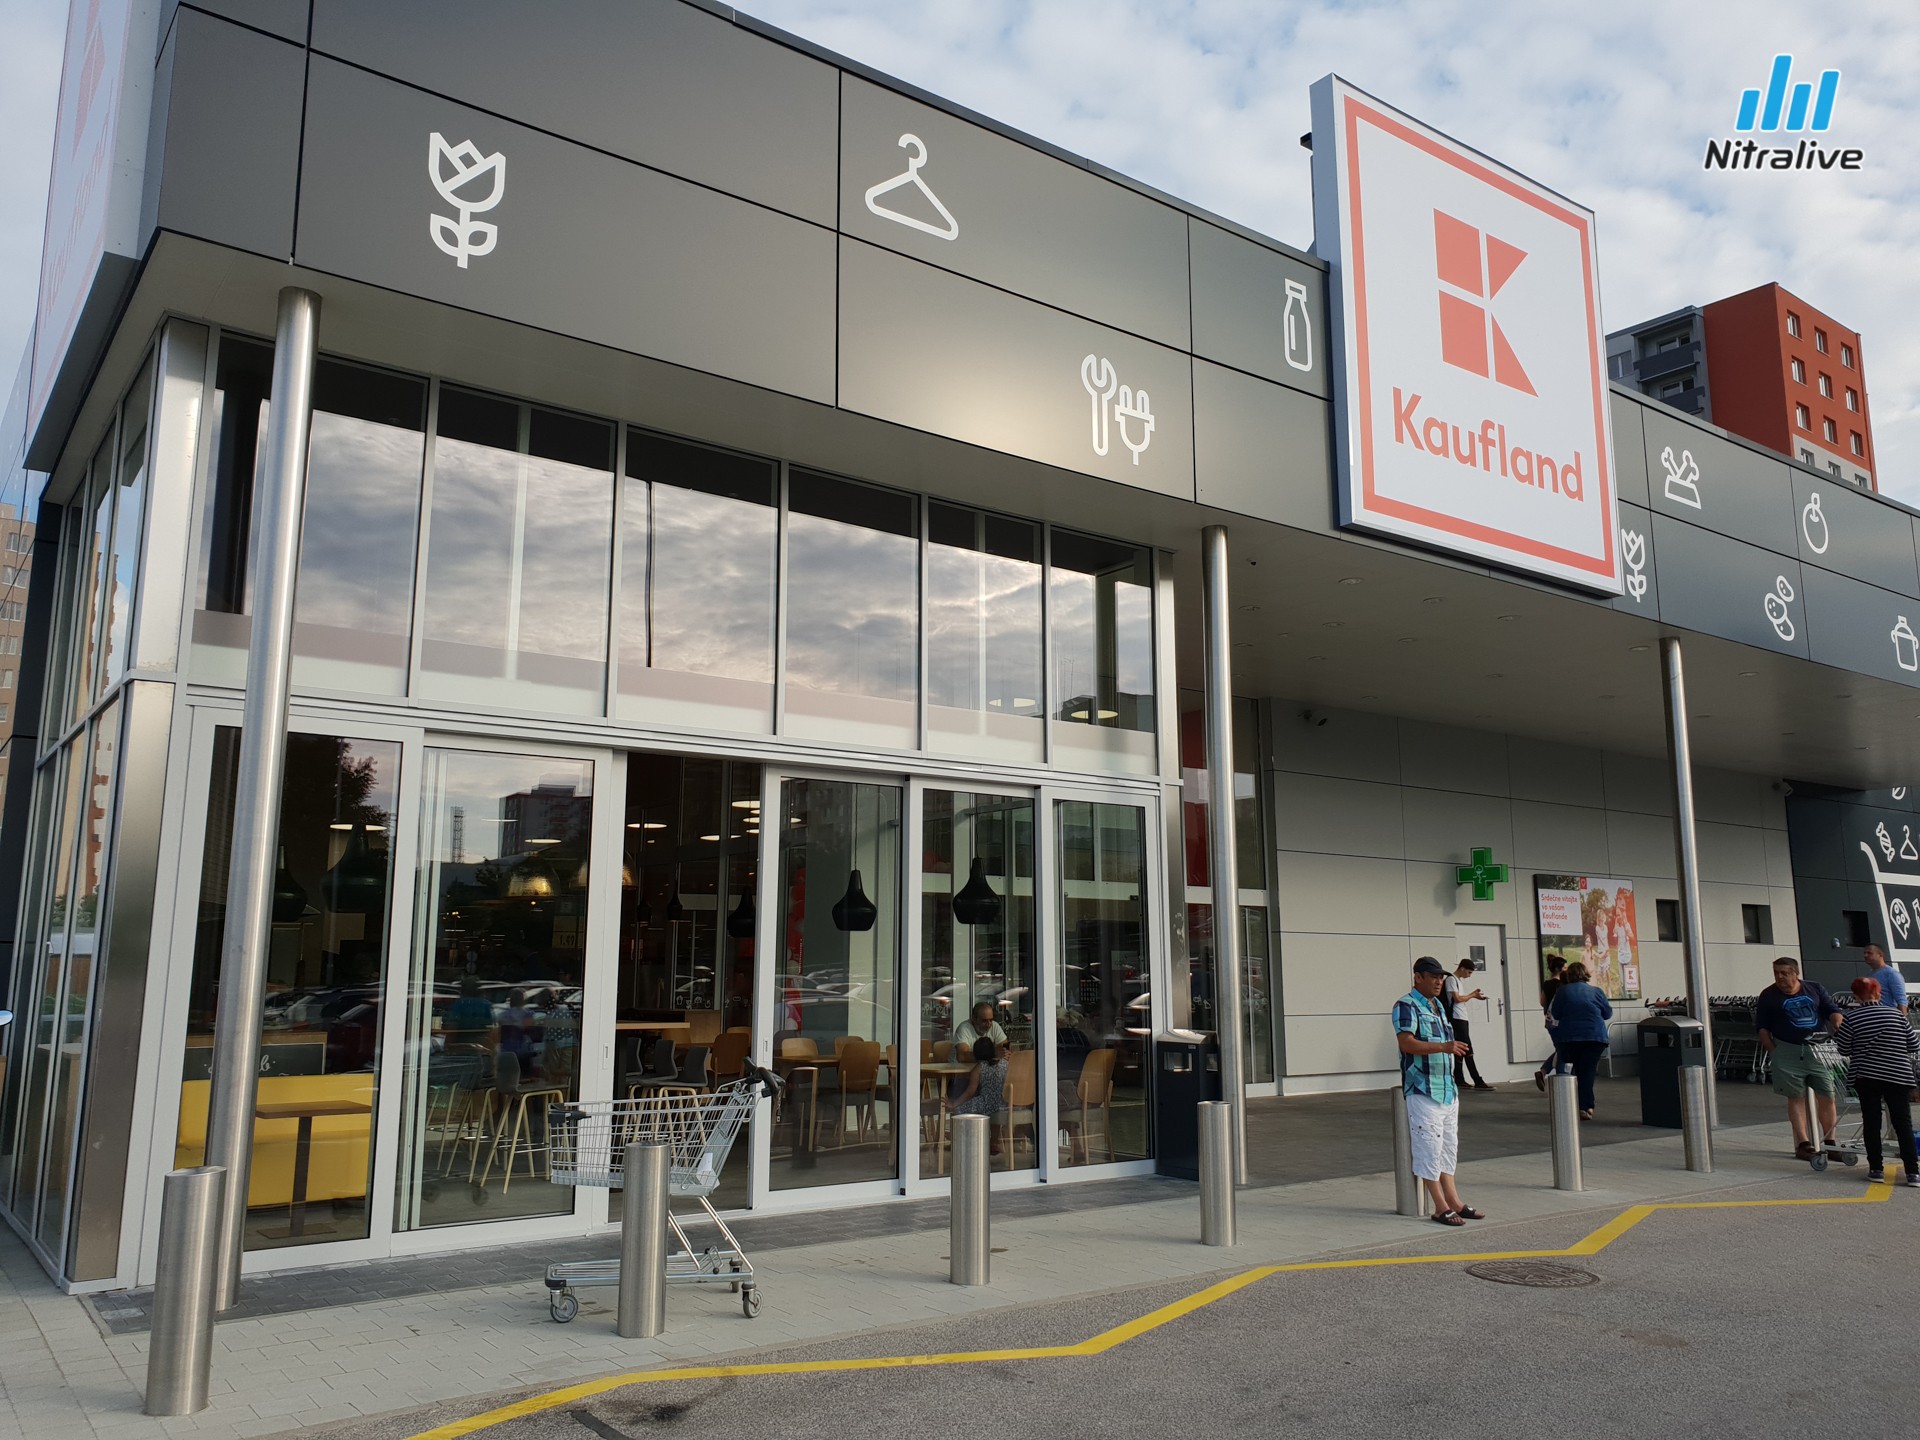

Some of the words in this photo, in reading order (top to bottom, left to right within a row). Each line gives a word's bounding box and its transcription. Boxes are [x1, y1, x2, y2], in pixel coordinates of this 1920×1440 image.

[1392, 386, 1584, 502] Kaufland
[1541, 893, 1561, 902] Srdečne
[1542, 912, 1568, 920] Kauflande
